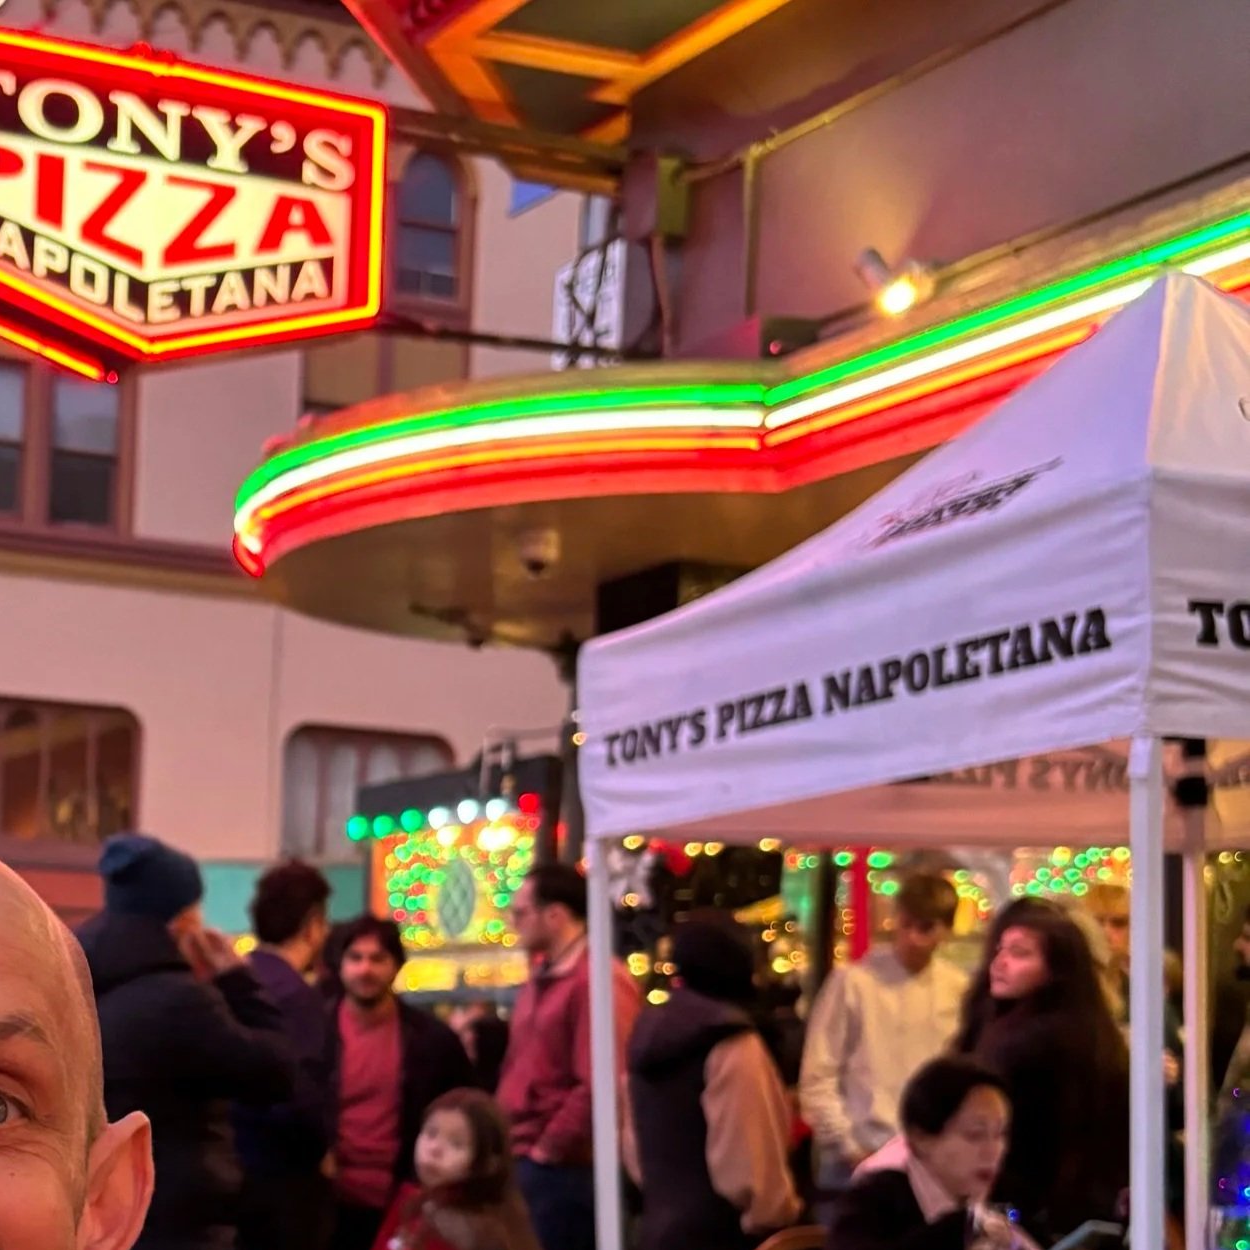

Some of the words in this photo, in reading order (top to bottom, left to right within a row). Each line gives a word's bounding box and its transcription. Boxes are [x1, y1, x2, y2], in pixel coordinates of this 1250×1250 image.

[603, 707, 708, 768] TONY'S
[716, 681, 813, 740] PIZZA
[822, 605, 1113, 716] NAPOLETANA
